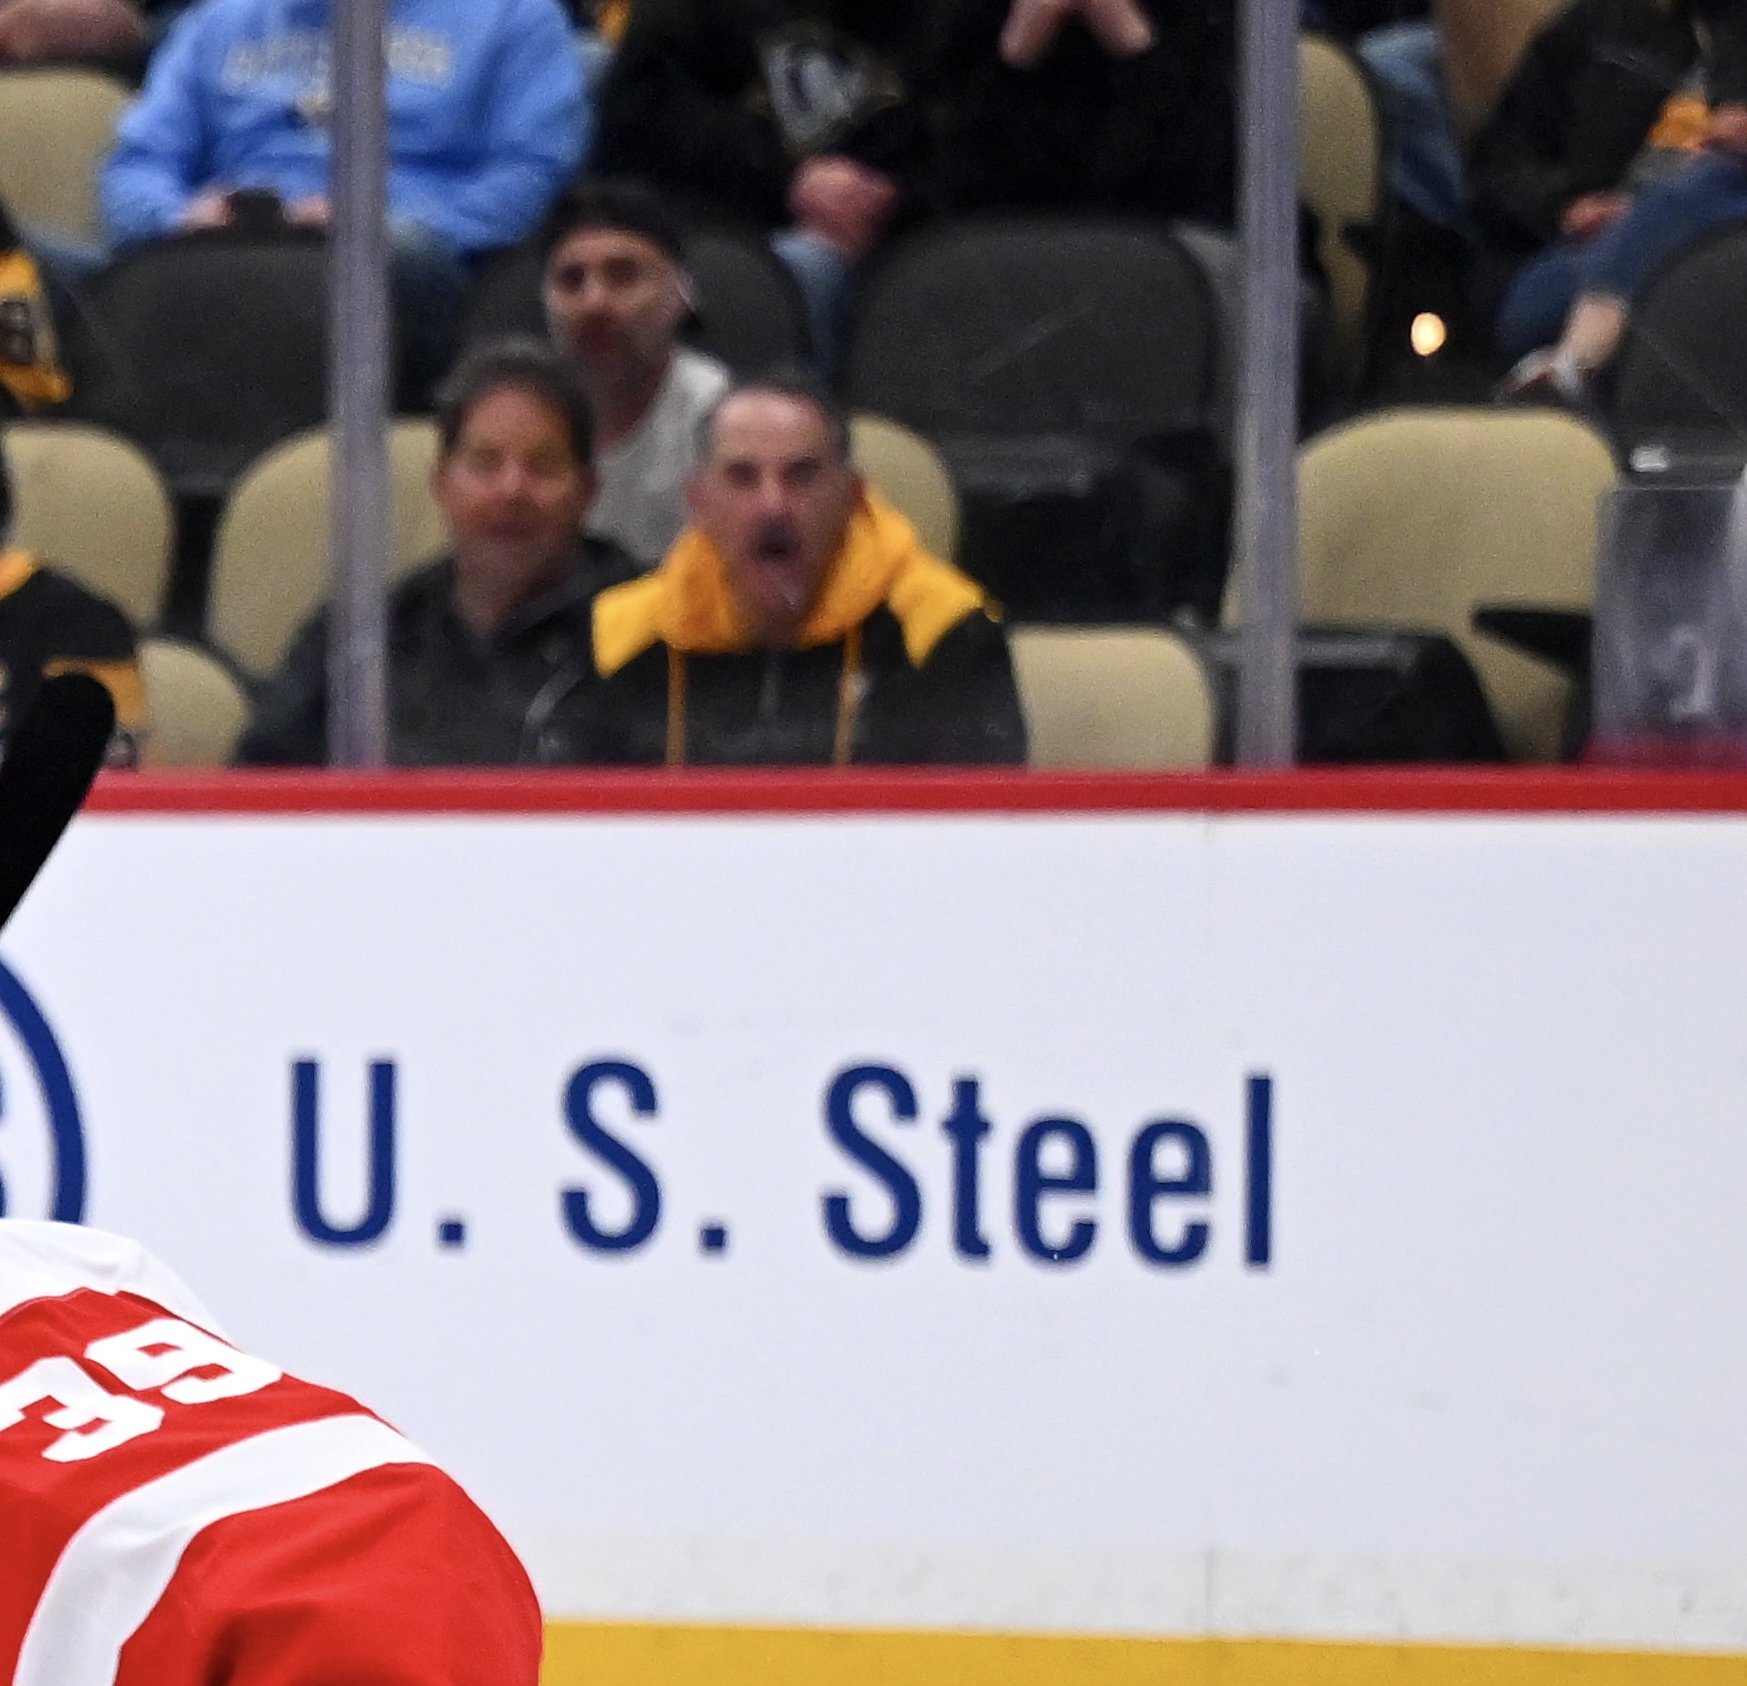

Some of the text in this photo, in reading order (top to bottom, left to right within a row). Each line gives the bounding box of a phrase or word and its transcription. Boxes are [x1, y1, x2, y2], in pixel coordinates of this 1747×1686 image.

[290, 1060, 1274, 1266] U. S. Steel
